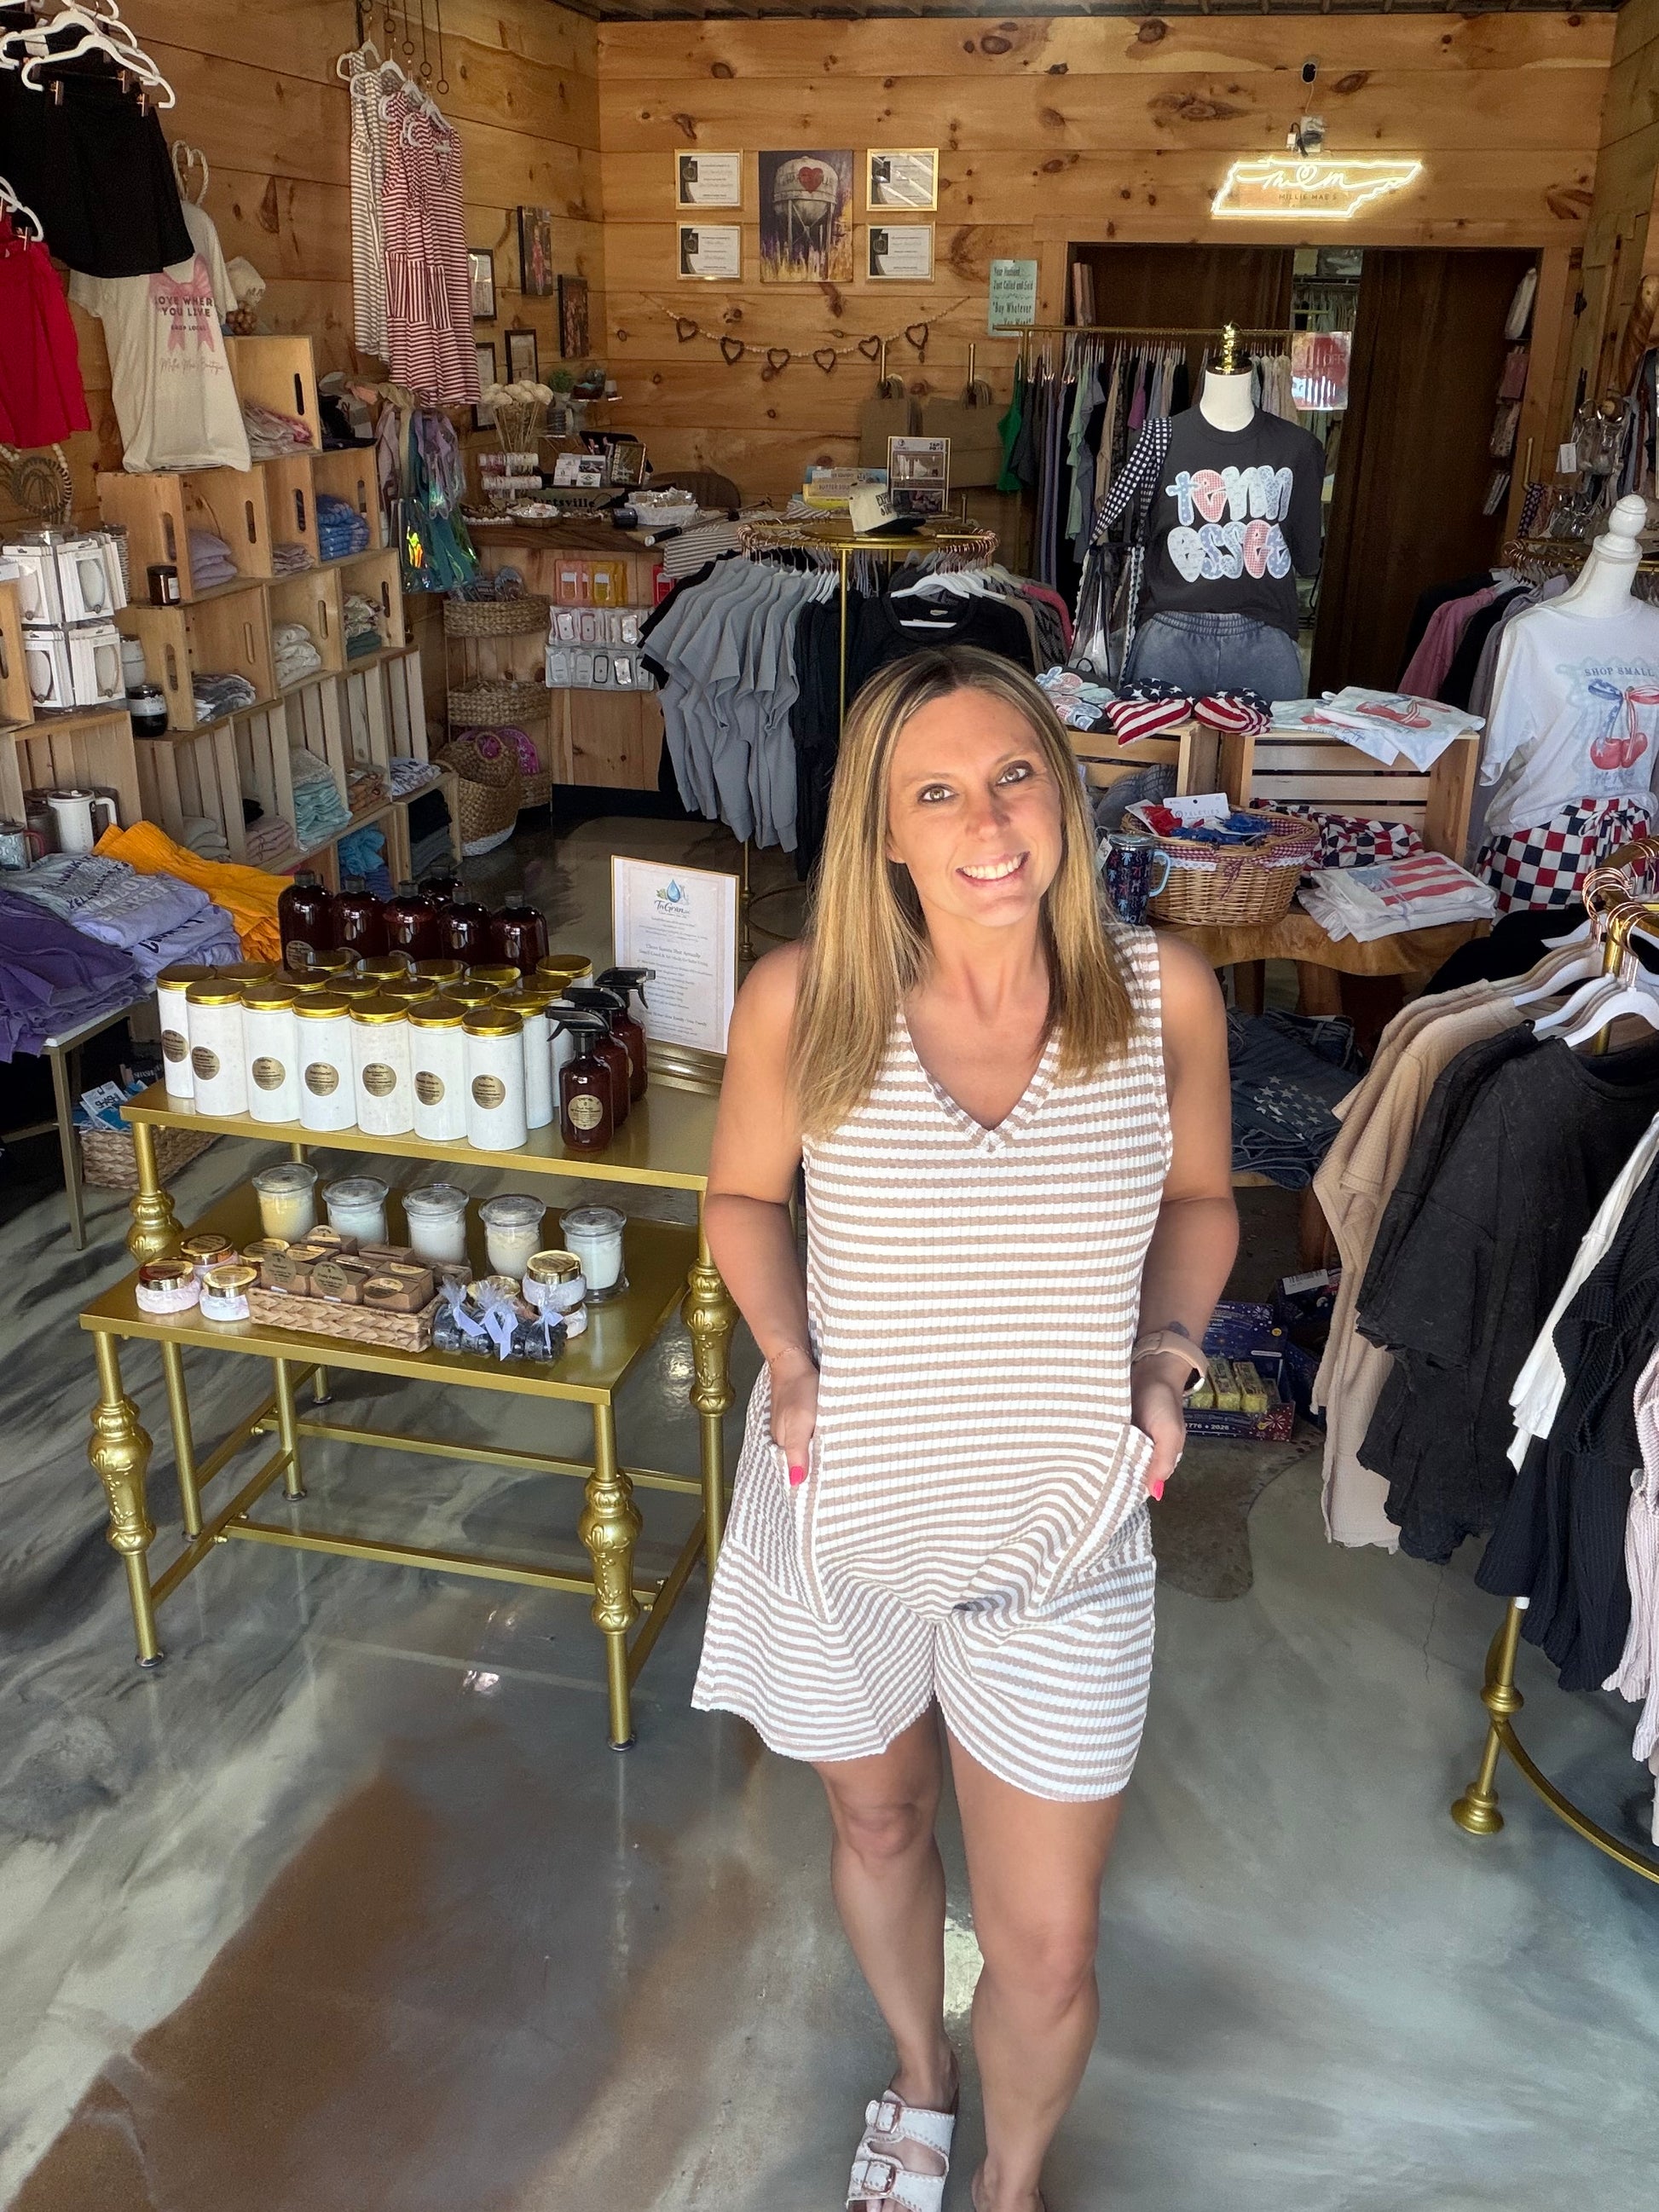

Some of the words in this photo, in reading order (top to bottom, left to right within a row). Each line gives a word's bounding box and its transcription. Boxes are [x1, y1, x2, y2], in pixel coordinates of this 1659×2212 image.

[155, 295, 179, 305] OVE
[182, 296, 214, 307] WHER
[162, 307, 183, 316] YOU
[187, 308, 211, 317] LIVE
[1584, 667, 1614, 677] SHOP
[1618, 667, 1656, 677] SMALL
